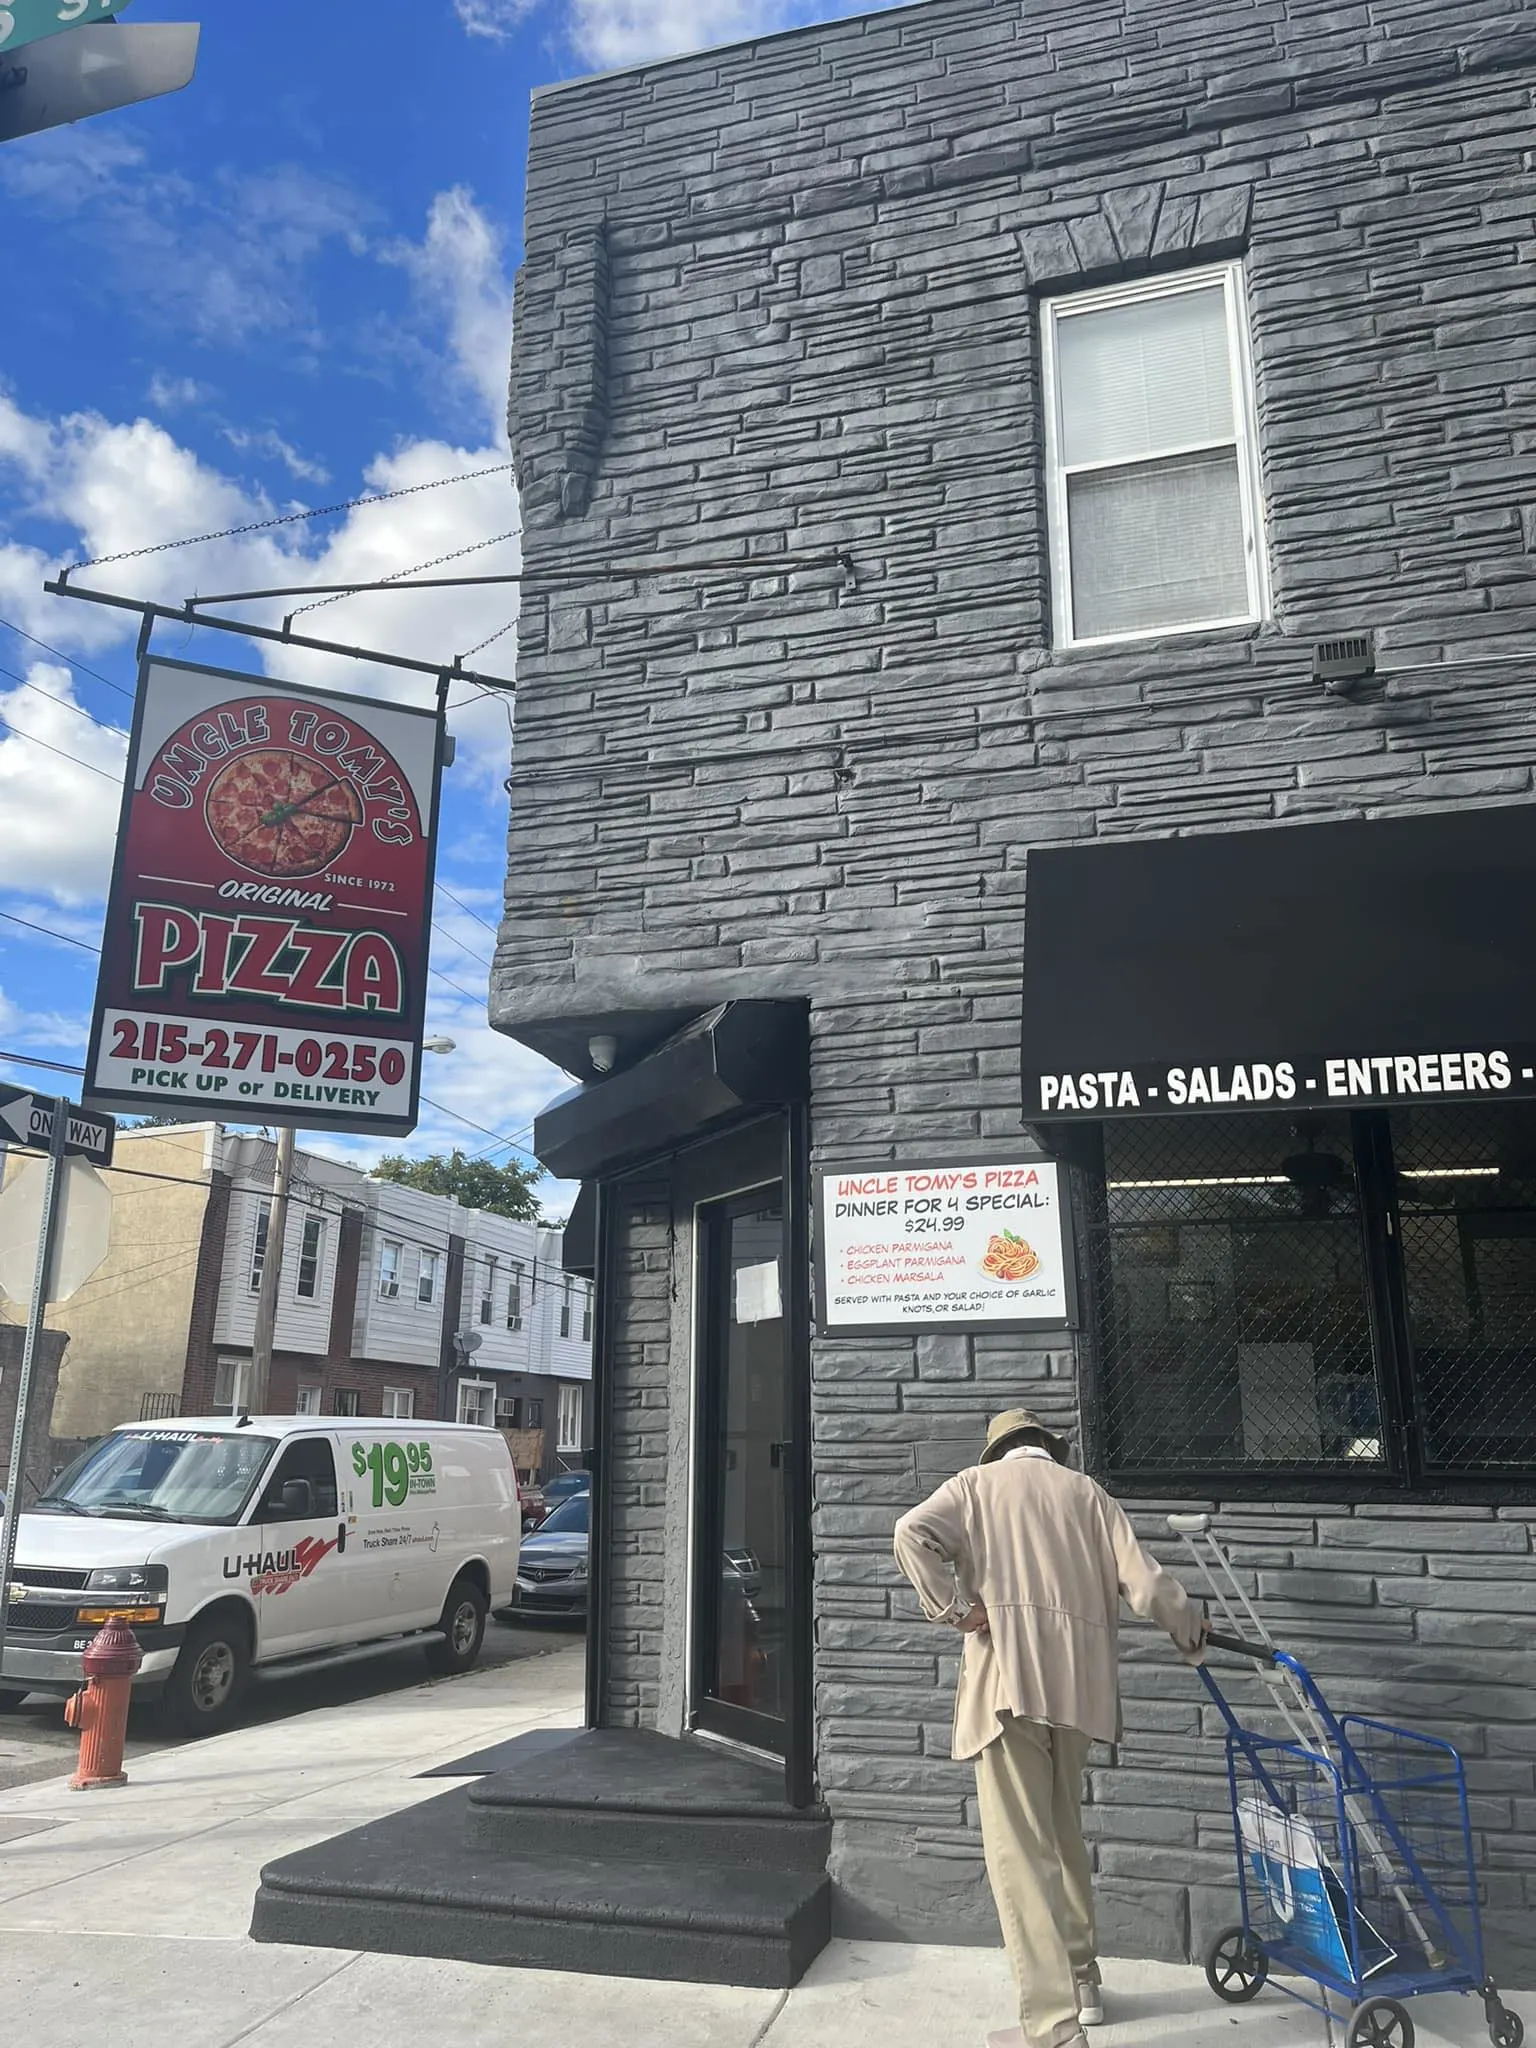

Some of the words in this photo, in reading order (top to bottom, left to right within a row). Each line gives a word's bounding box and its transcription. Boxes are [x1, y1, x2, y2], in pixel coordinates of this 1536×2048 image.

[150, 704, 271, 809] UNCLE
[288, 710, 413, 846] TOMY'S
[217, 879, 335, 911] ORIGINAL
[324, 873, 363, 887] SINCE
[368, 879, 396, 892] 1972
[133, 901, 402, 1013] PIZZA
[109, 1018, 406, 1085] 215-271-0250
[131, 1068, 188, 1089] PICK
[196, 1074, 229, 1092] UP
[238, 1081, 264, 1095] or
[274, 1081, 381, 1106] DELIVERY
[1039, 1071, 1140, 1111] PASTA
[1167, 1062, 1297, 1104] SALADS
[1324, 1050, 1512, 1097] ENTREERS
[30, 1110, 54, 1135] ON
[70, 1120, 102, 1147] WAY
[838, 1176, 898, 1196] UNCLE
[905, 1172, 978, 1192] TOMY'S
[984, 1169, 1040, 1189] PIZZA
[835, 1200, 899, 1218] DINNER
[904, 1198, 942, 1215] FOR
[947, 1197, 958, 1211] 4
[965, 1193, 1050, 1211] SPECIAL:
[904, 1216, 965, 1233] $24.99
[846, 1244, 889, 1255] CHICKEN
[892, 1241, 953, 1253] PARMIGANA
[847, 1258, 902, 1270] EGGPLANT
[904, 1255, 967, 1267] PARMIGANA
[847, 1273, 891, 1285] CHICKEN
[893, 1271, 945, 1283] MARSALA
[834, 1296, 869, 1305] SERVED
[871, 1295, 892, 1303] WITH
[894, 1293, 920, 1302] PASTA
[922, 1292, 941, 1301] AND
[943, 1291, 967, 1300] YOUR
[969, 1290, 1003, 1299] CHOICE
[1005, 1289, 1020, 1298] OF
[1022, 1288, 1056, 1297] GARLIC
[951, 1302, 985, 1312] SALAD!
[140, 1431, 199, 1441] U-HAUL
[363, 1538, 381, 1550] Truck
[223, 1549, 302, 1578] U-HAUL
